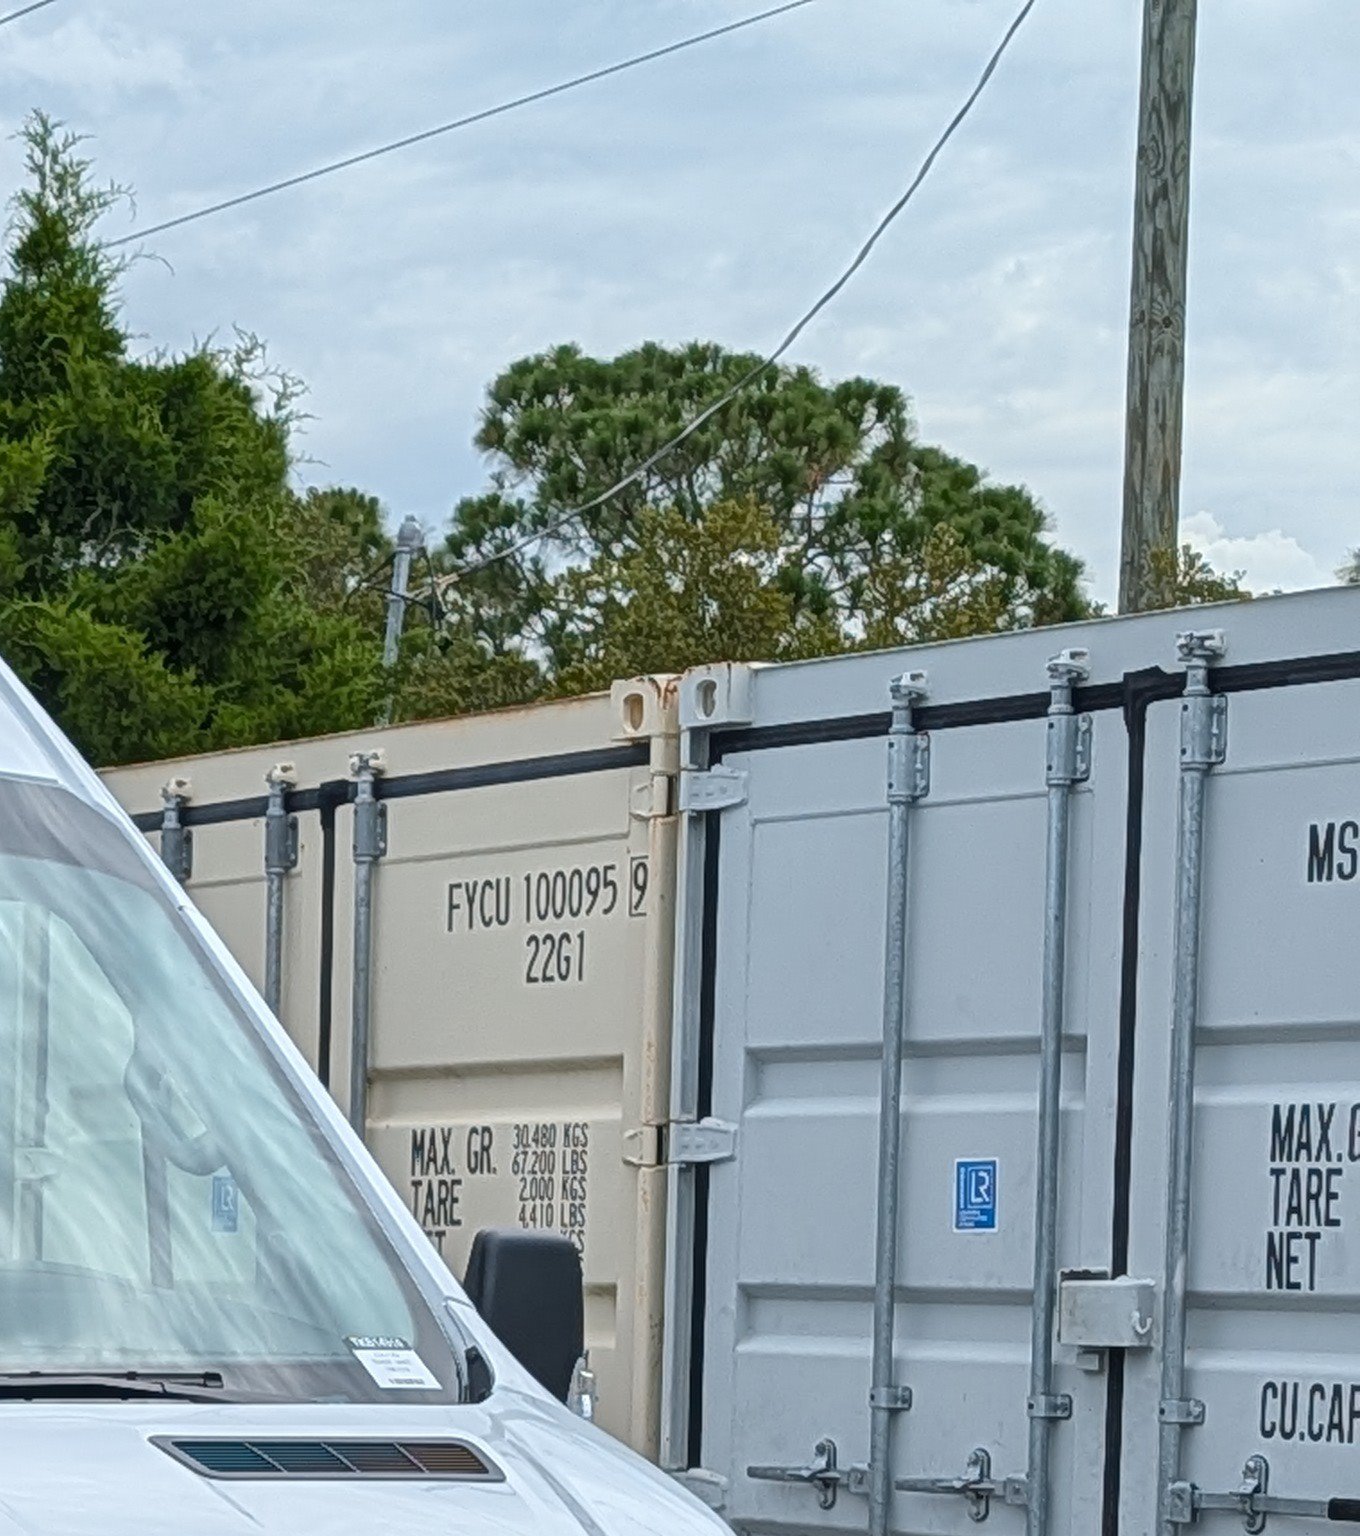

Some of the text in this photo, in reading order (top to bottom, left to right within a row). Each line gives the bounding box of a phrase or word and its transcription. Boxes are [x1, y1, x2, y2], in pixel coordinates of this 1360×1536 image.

[1307, 821, 1359, 883] MS
[447, 861, 648, 932] FYCU 100095 9
[526, 930, 585, 983] 22G1
[411, 1128, 456, 1176] MAX.
[467, 1126, 498, 1175] GR.
[564, 1122, 589, 1148] KGS
[562, 1149, 588, 1175] LBS
[411, 1179, 462, 1227] TARE
[562, 1176, 587, 1201] KGS
[971, 1170, 990, 1203] LR
[1270, 1167, 1343, 1227] TARE
[561, 1203, 586, 1228] LBS
[1266, 1231, 1321, 1290] NET
